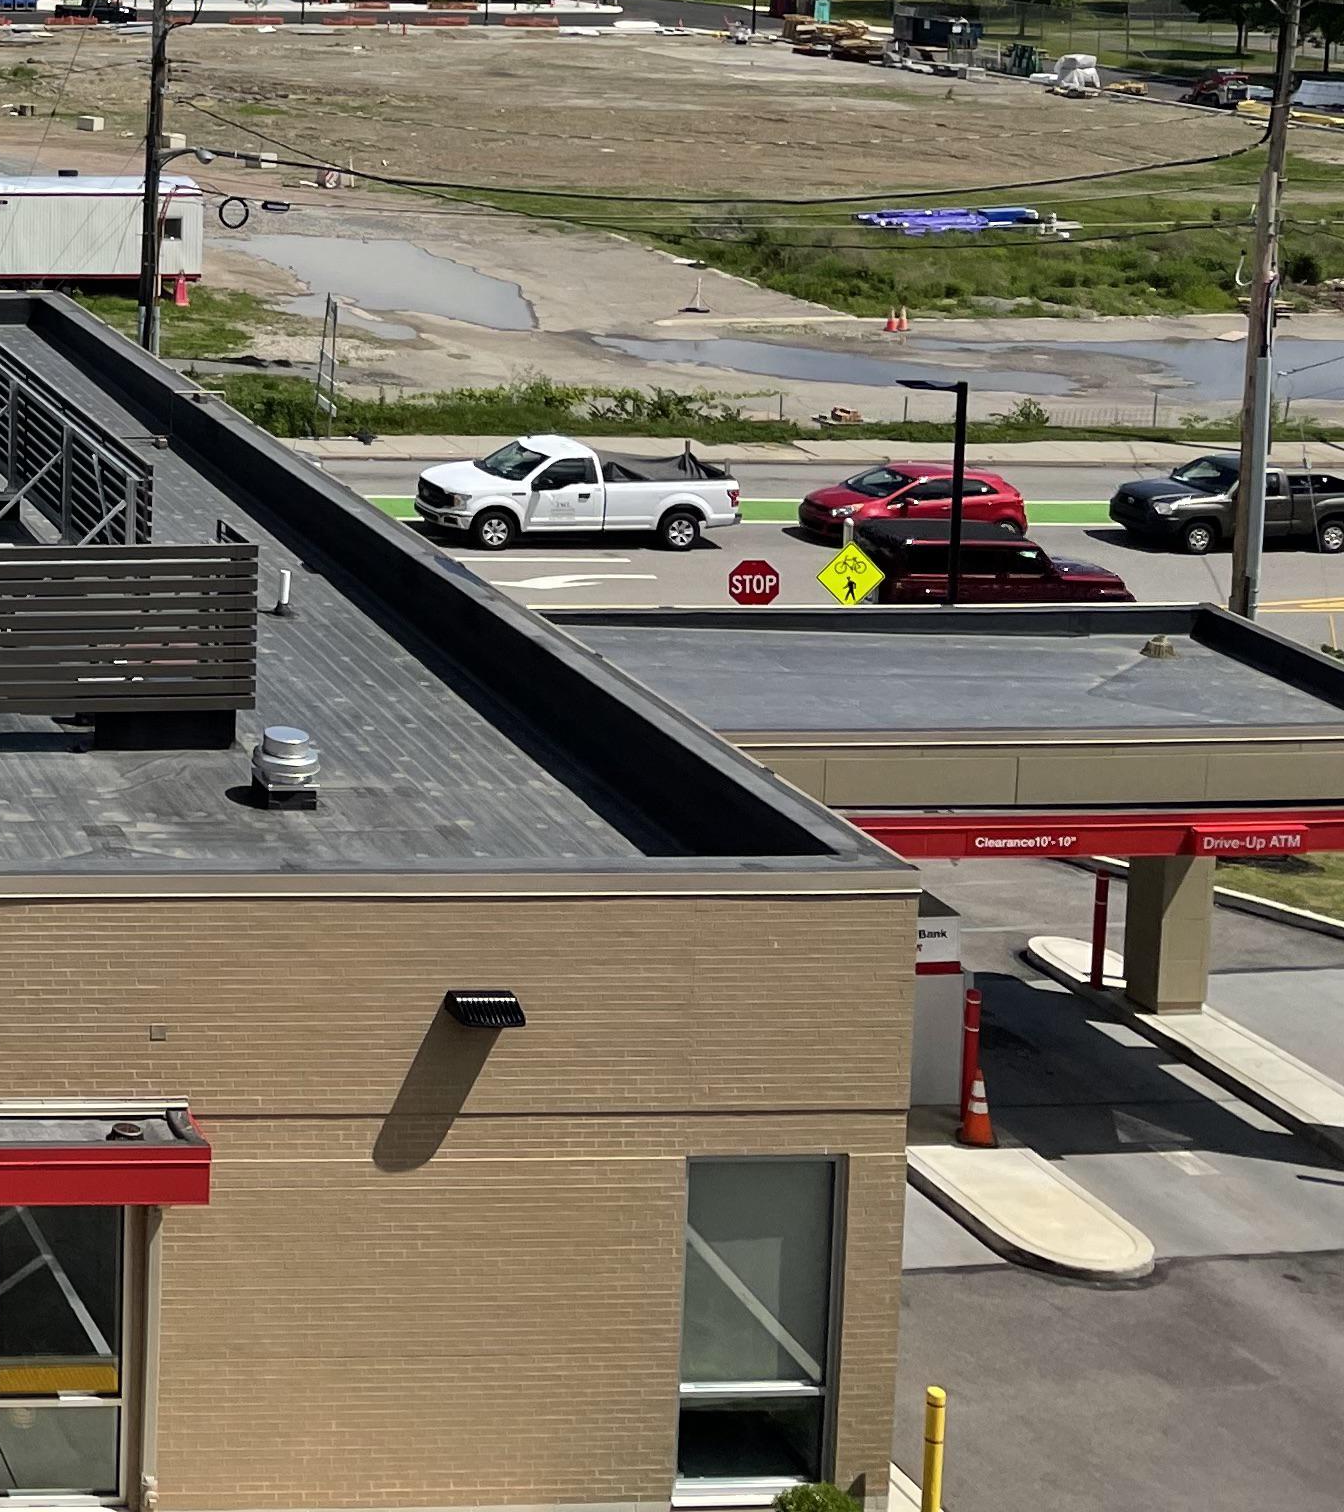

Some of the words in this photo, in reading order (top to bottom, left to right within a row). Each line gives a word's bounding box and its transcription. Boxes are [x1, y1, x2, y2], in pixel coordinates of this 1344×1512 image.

[731, 574, 777, 594] STOP
[1203, 835, 1266, 851] Drive-Up
[1269, 834, 1301, 848] ATM
[918, 929, 949, 939] Bank
